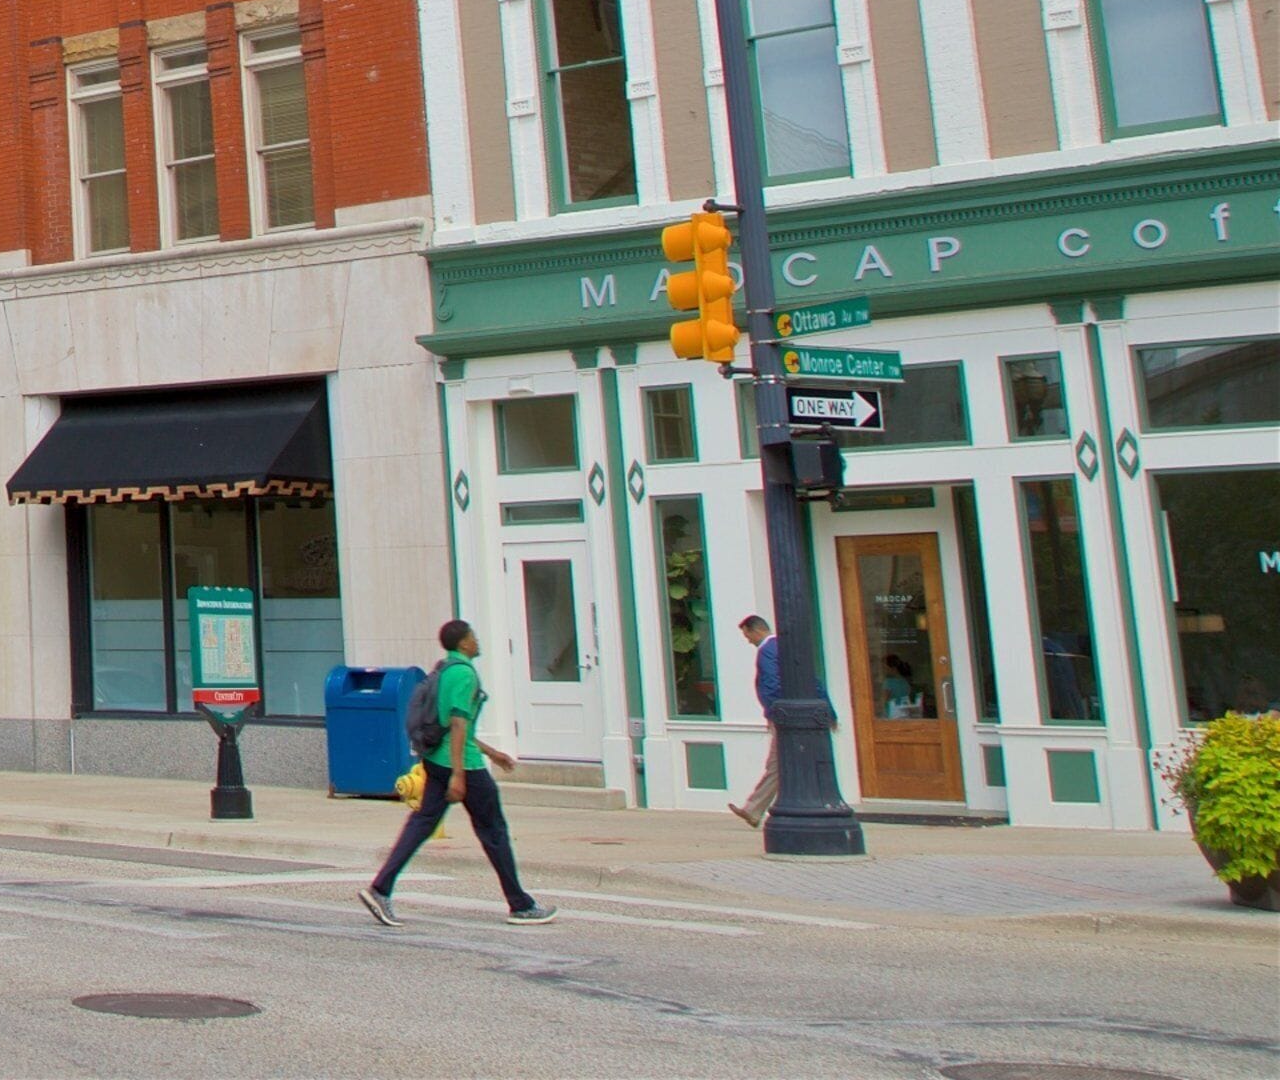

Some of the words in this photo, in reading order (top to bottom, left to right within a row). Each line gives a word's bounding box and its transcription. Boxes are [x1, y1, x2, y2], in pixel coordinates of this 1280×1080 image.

[1058, 199, 1280, 258] cof
[792, 310, 837, 332] Ottawa
[800, 351, 843, 374] Monroe
[846, 353, 884, 376] Center
[796, 399, 826, 415] ONE
[827, 400, 854, 416] WAY
